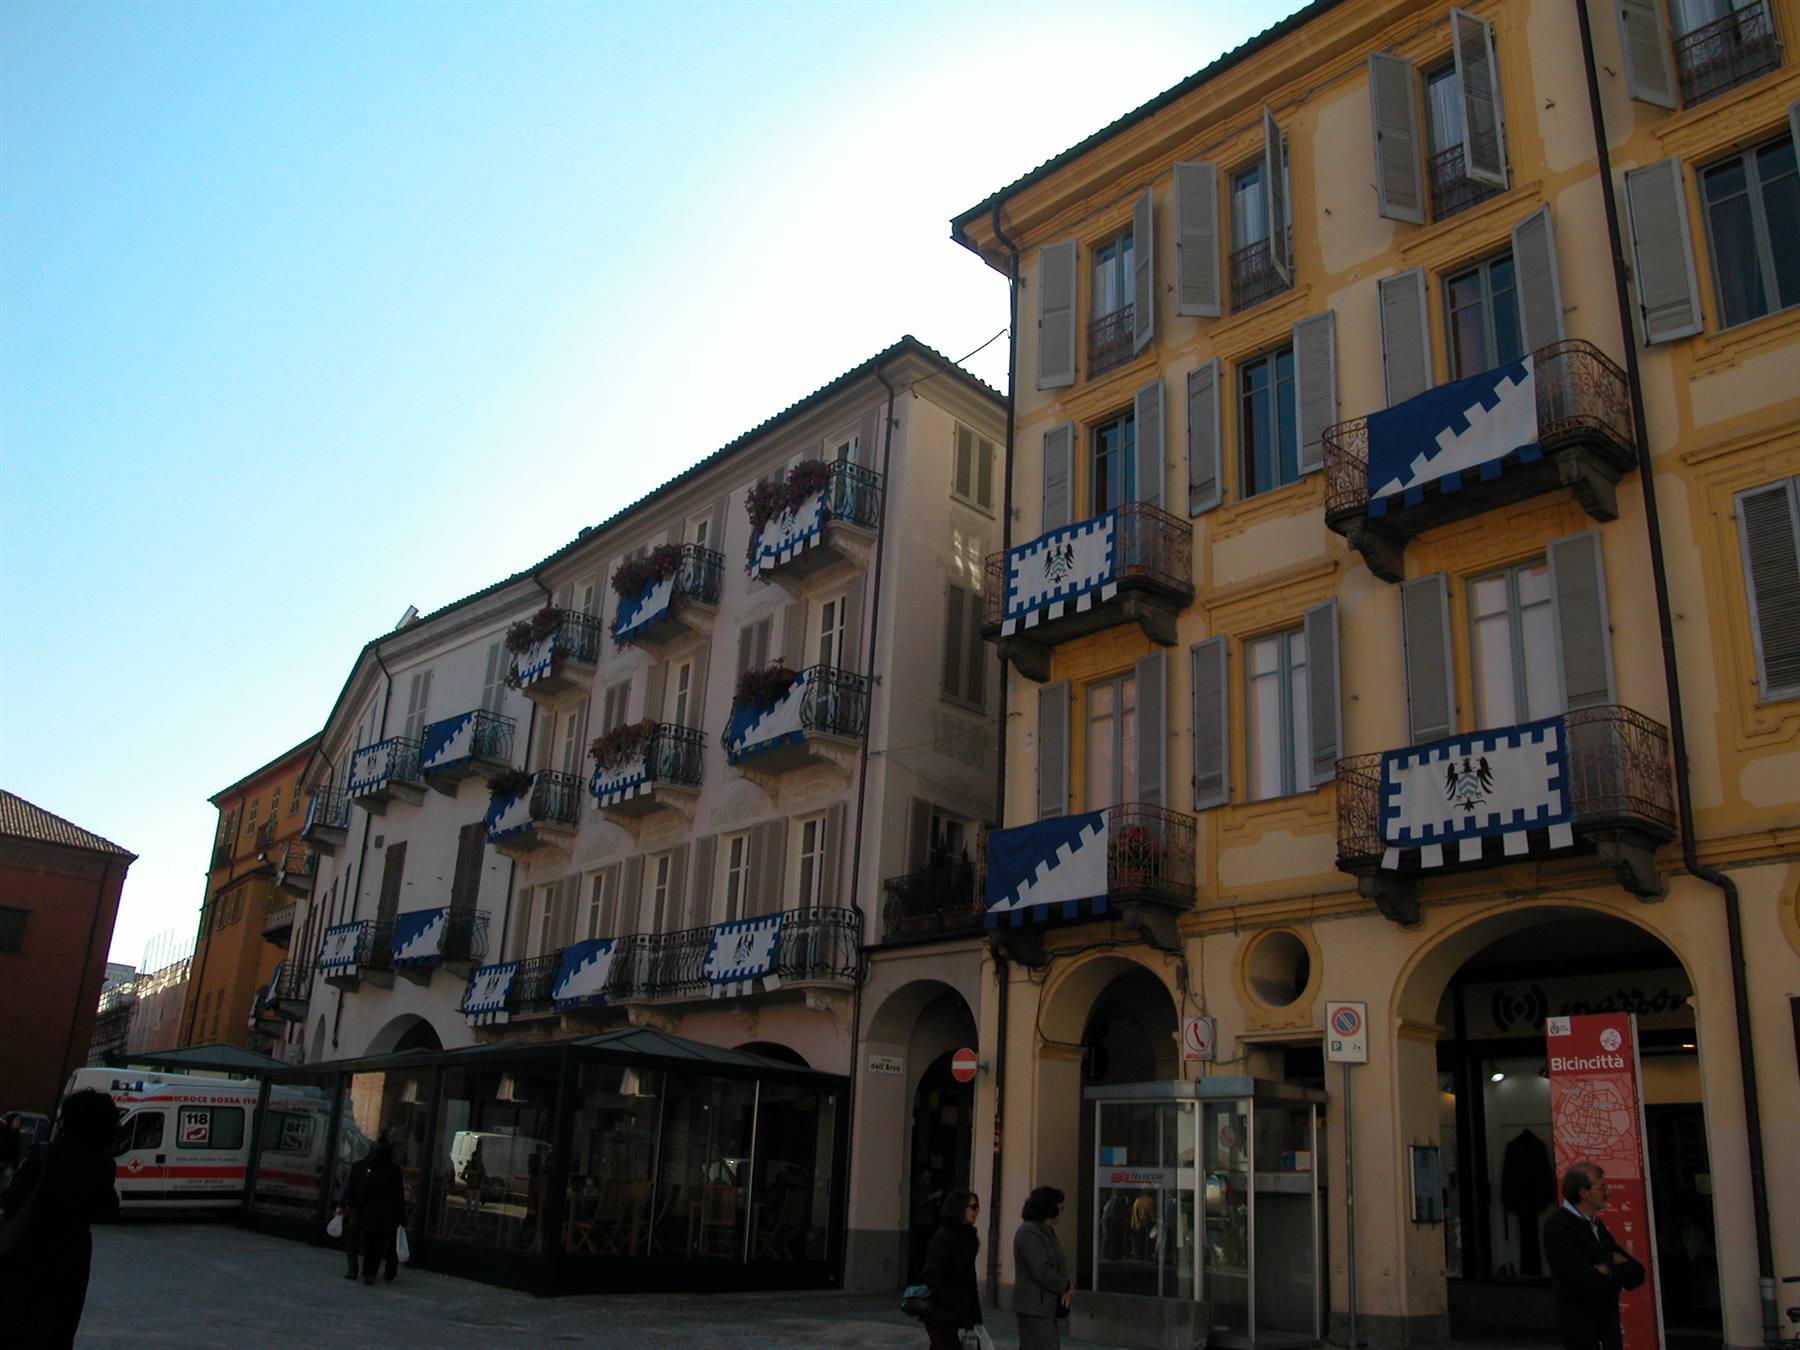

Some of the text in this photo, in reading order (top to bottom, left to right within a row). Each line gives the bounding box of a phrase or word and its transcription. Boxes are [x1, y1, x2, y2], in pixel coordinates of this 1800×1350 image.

[1551, 1054, 1624, 1071] Bicincittà
[210, 1096, 240, 1104] ROSSA
[187, 1113, 208, 1124] 118
[1131, 1172, 1164, 1180] TELECOM
